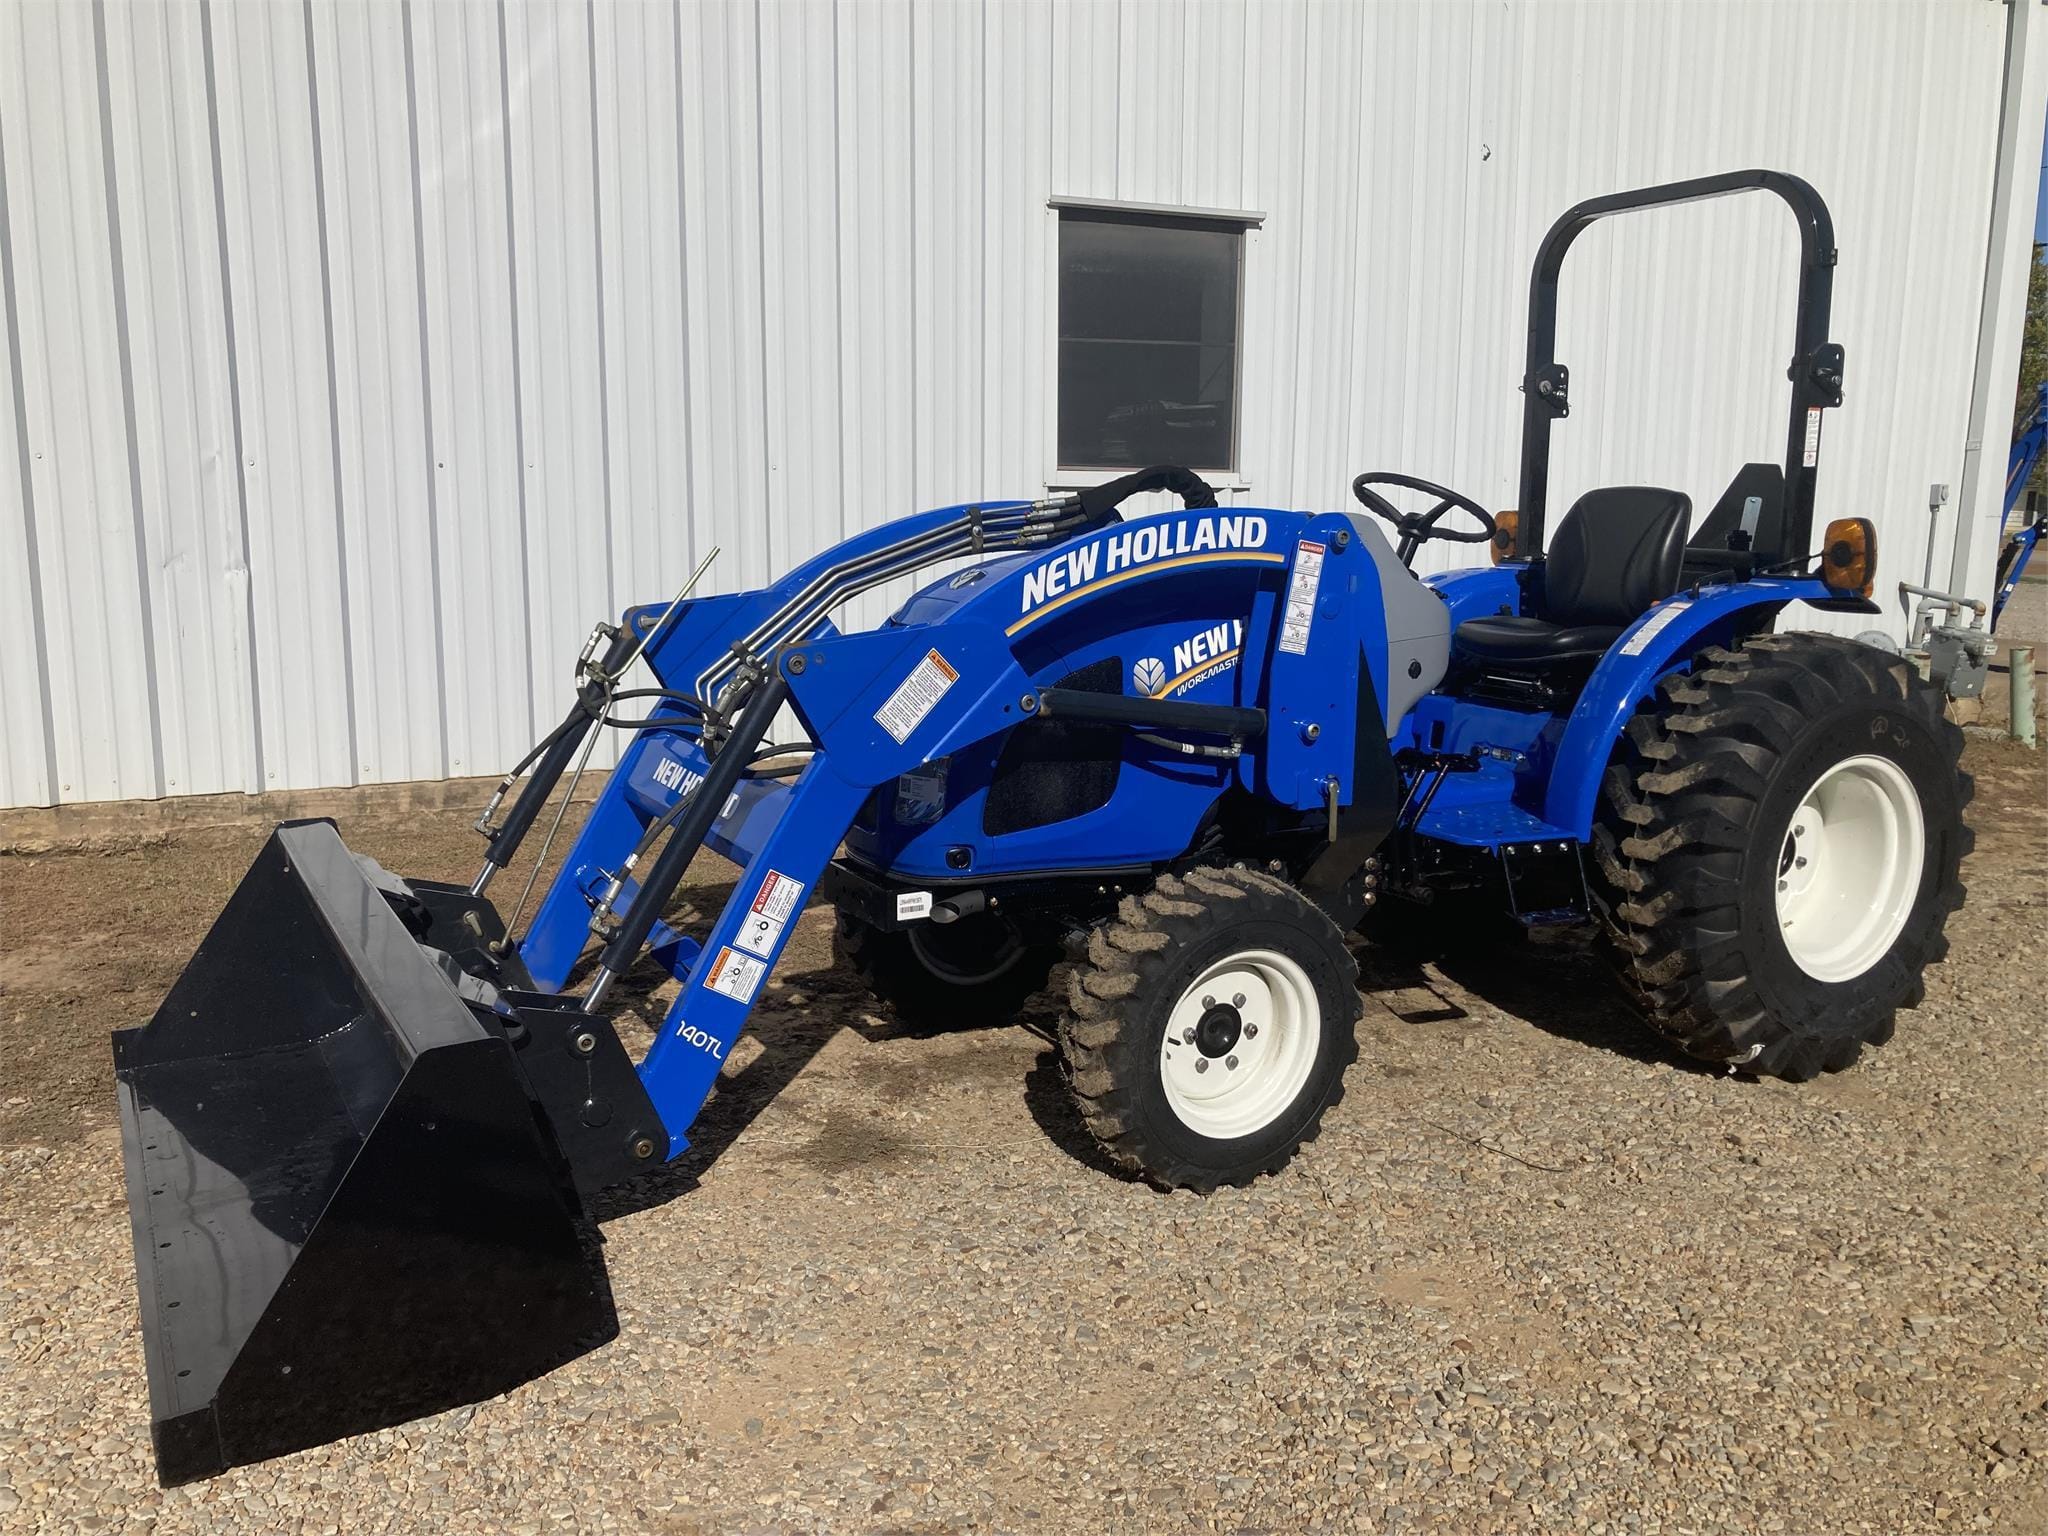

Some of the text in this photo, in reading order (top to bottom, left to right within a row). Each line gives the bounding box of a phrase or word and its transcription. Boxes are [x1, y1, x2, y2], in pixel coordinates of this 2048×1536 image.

[1021, 516, 1268, 614] NEW HOLLAND
[1174, 622, 1228, 675] NEW
[652, 757, 687, 790] NEW
[676, 1020, 722, 1060] 140TL
